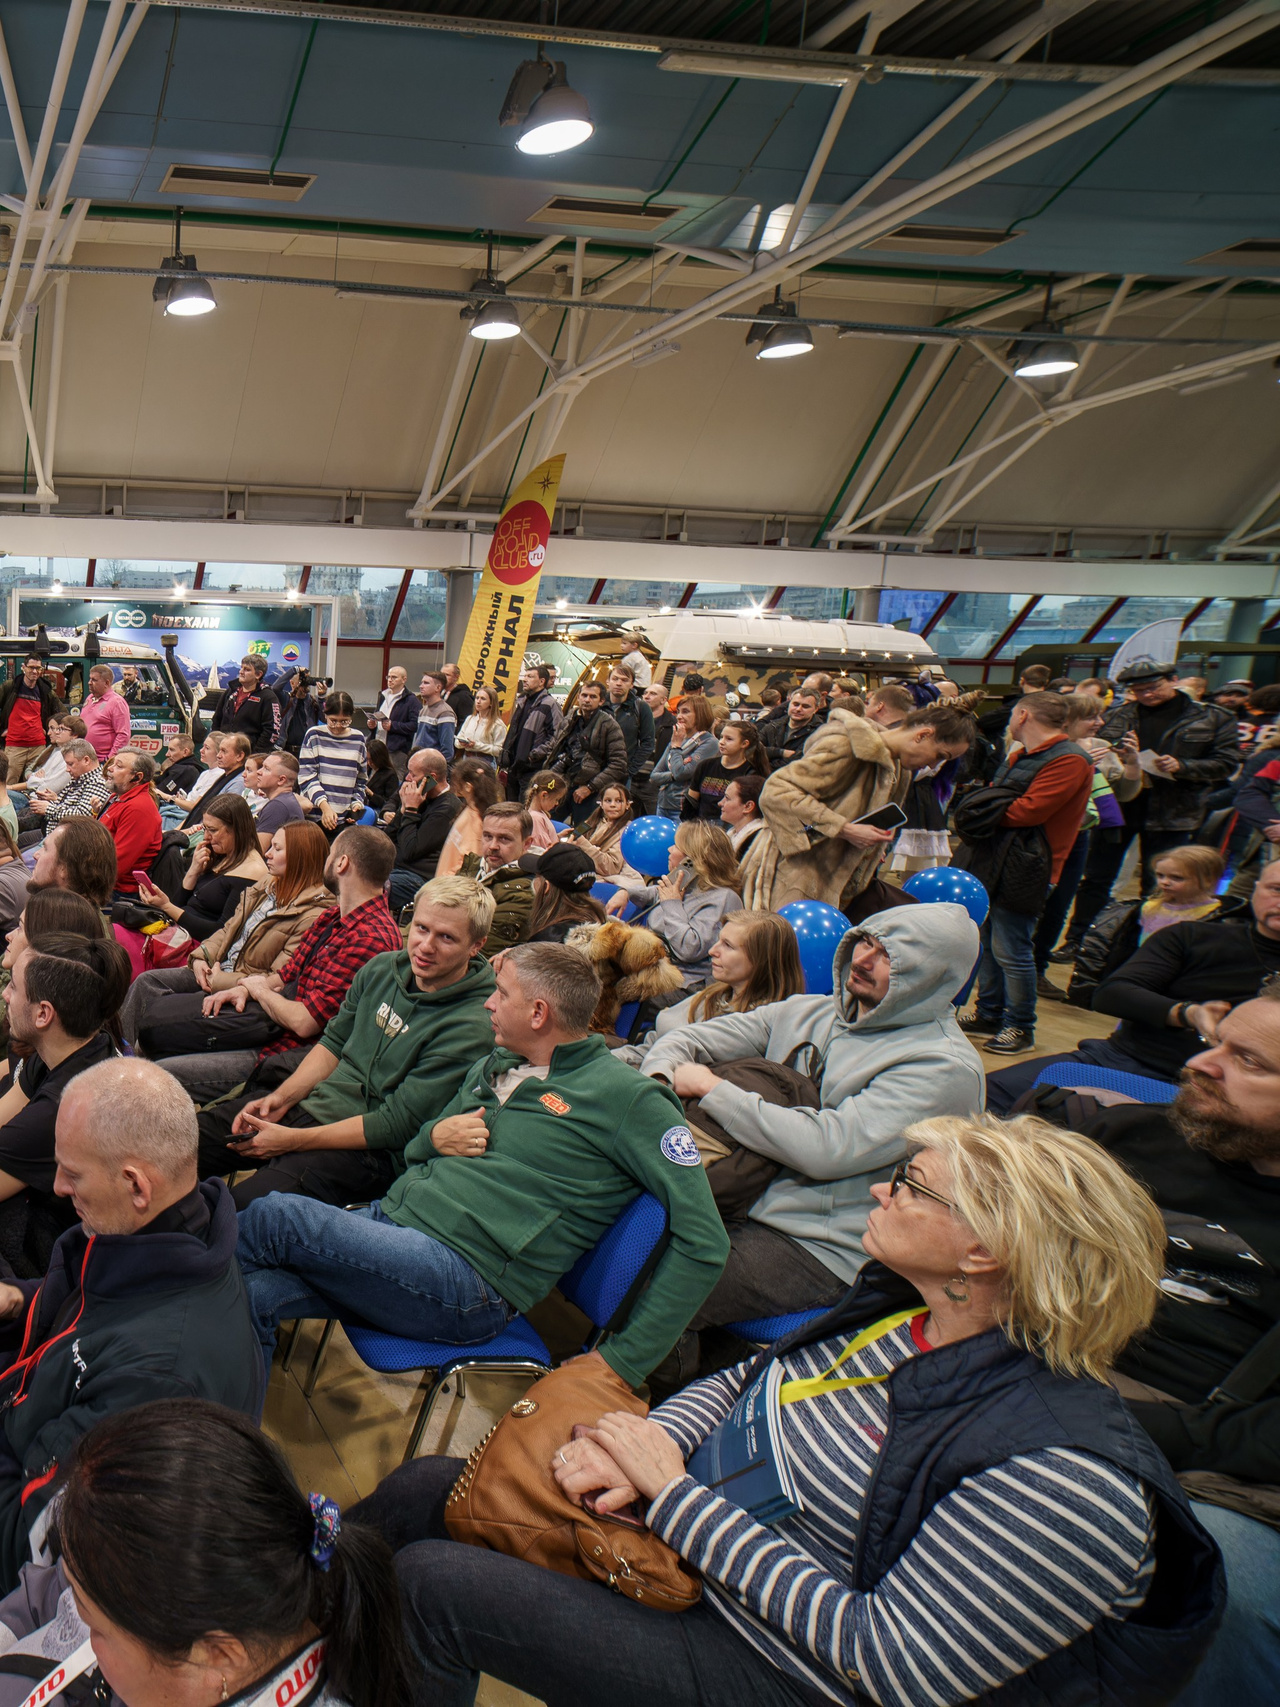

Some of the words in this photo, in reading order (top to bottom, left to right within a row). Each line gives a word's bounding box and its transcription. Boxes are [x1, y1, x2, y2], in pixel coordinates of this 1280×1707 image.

[499, 518, 531, 538] OFF
[495, 533, 539, 553] ROAD
[493, 551, 528, 569] CLUB
[153, 615, 220, 628] ПОЕХАЛИ
[471, 592, 503, 697] ЕДОРОЖНЫЙ
